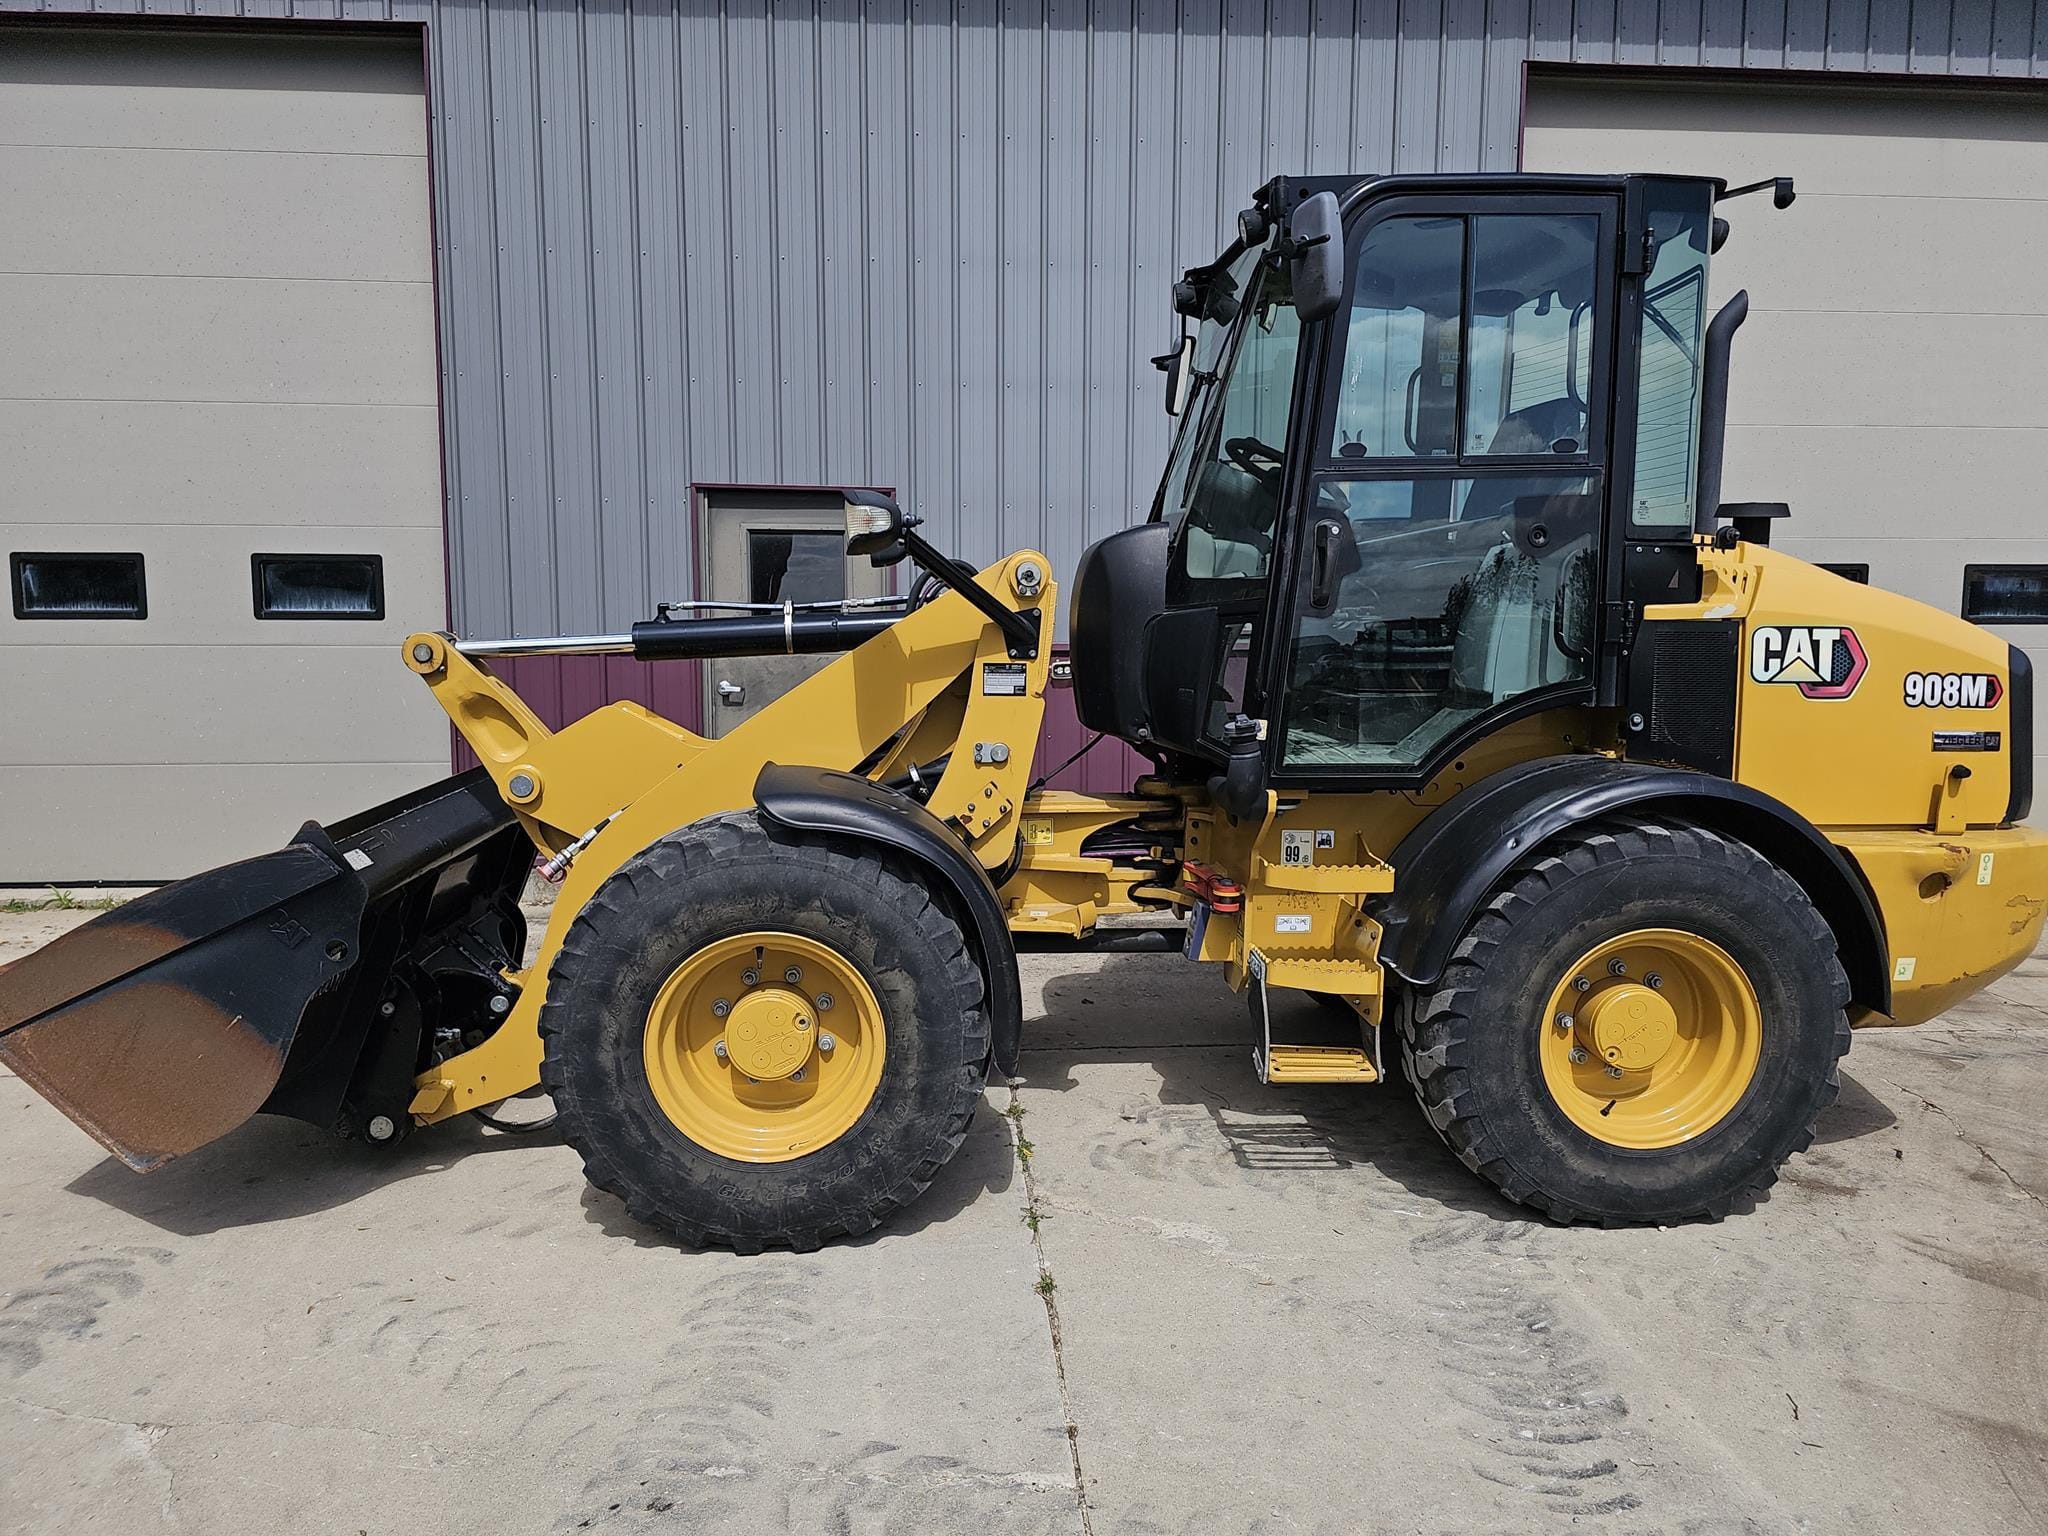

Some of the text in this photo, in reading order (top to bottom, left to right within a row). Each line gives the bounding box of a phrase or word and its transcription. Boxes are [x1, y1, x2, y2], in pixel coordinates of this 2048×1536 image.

[1752, 627, 1840, 682] CAT
[1905, 674, 1987, 707] 908M
[1285, 845, 1300, 863] 99
